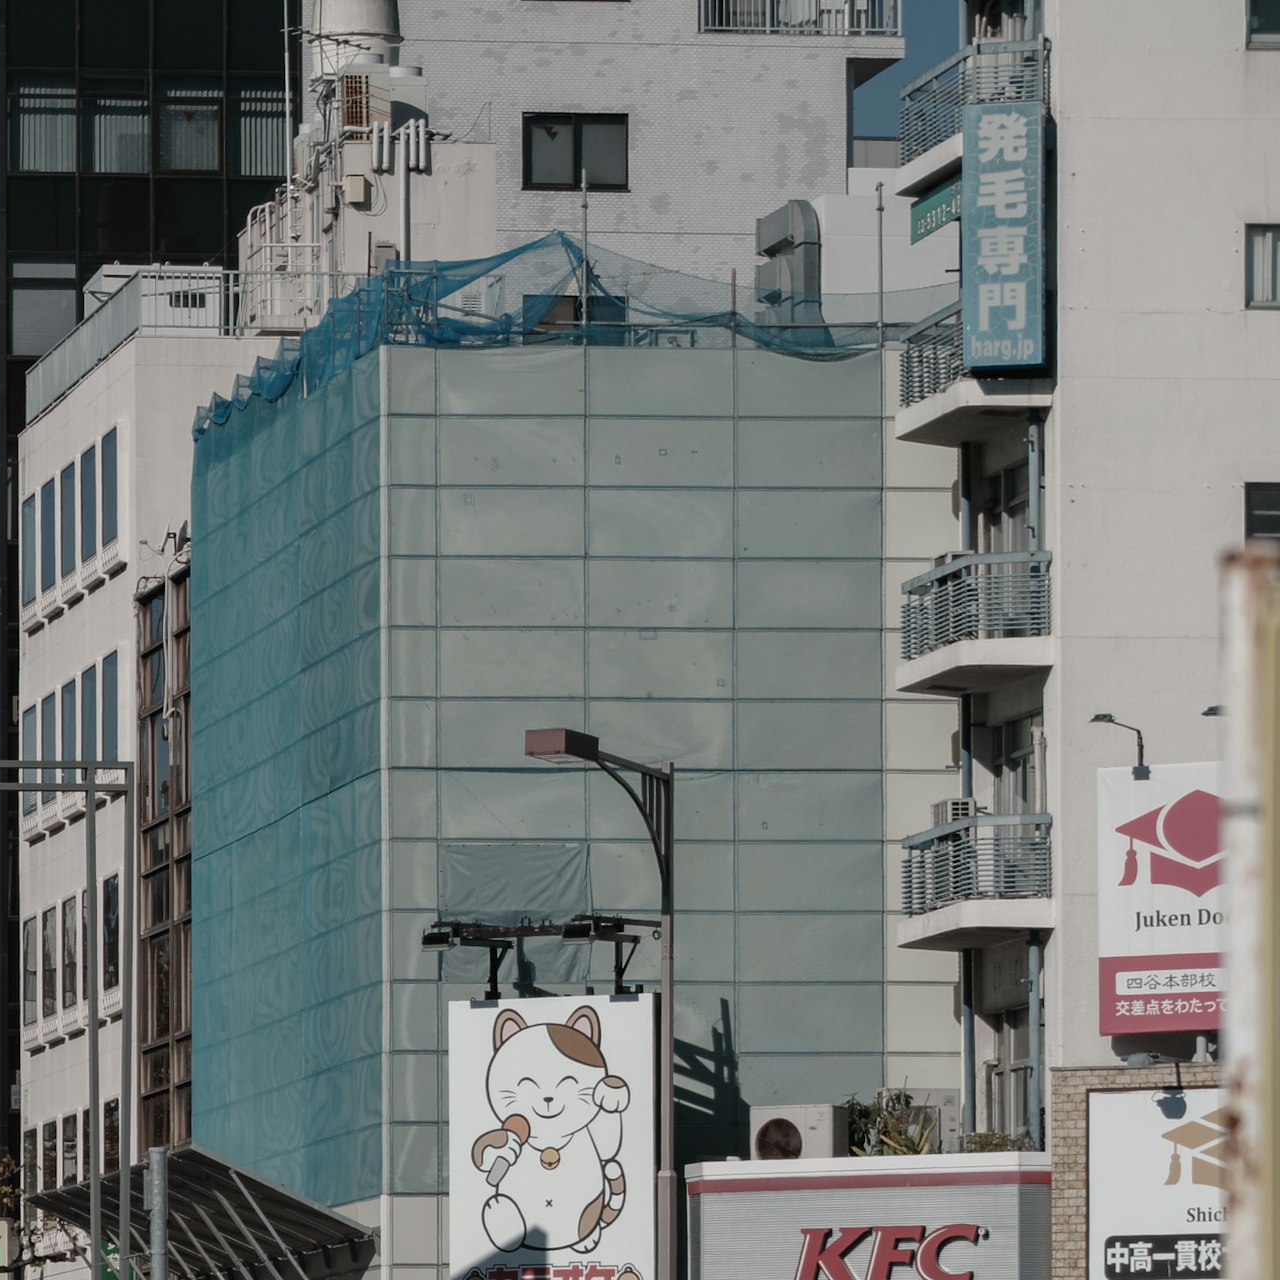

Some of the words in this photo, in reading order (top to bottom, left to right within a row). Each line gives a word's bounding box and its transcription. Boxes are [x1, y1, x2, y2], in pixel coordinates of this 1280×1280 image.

[977, 112, 1028, 332] 発毛専門
[970, 335, 1034, 361] harg.jp
[1135, 910, 1191, 932] Juken
[1126, 973, 1216, 990] 四谷本部校
[1106, 1239, 1227, 1273] 中高一貫校
